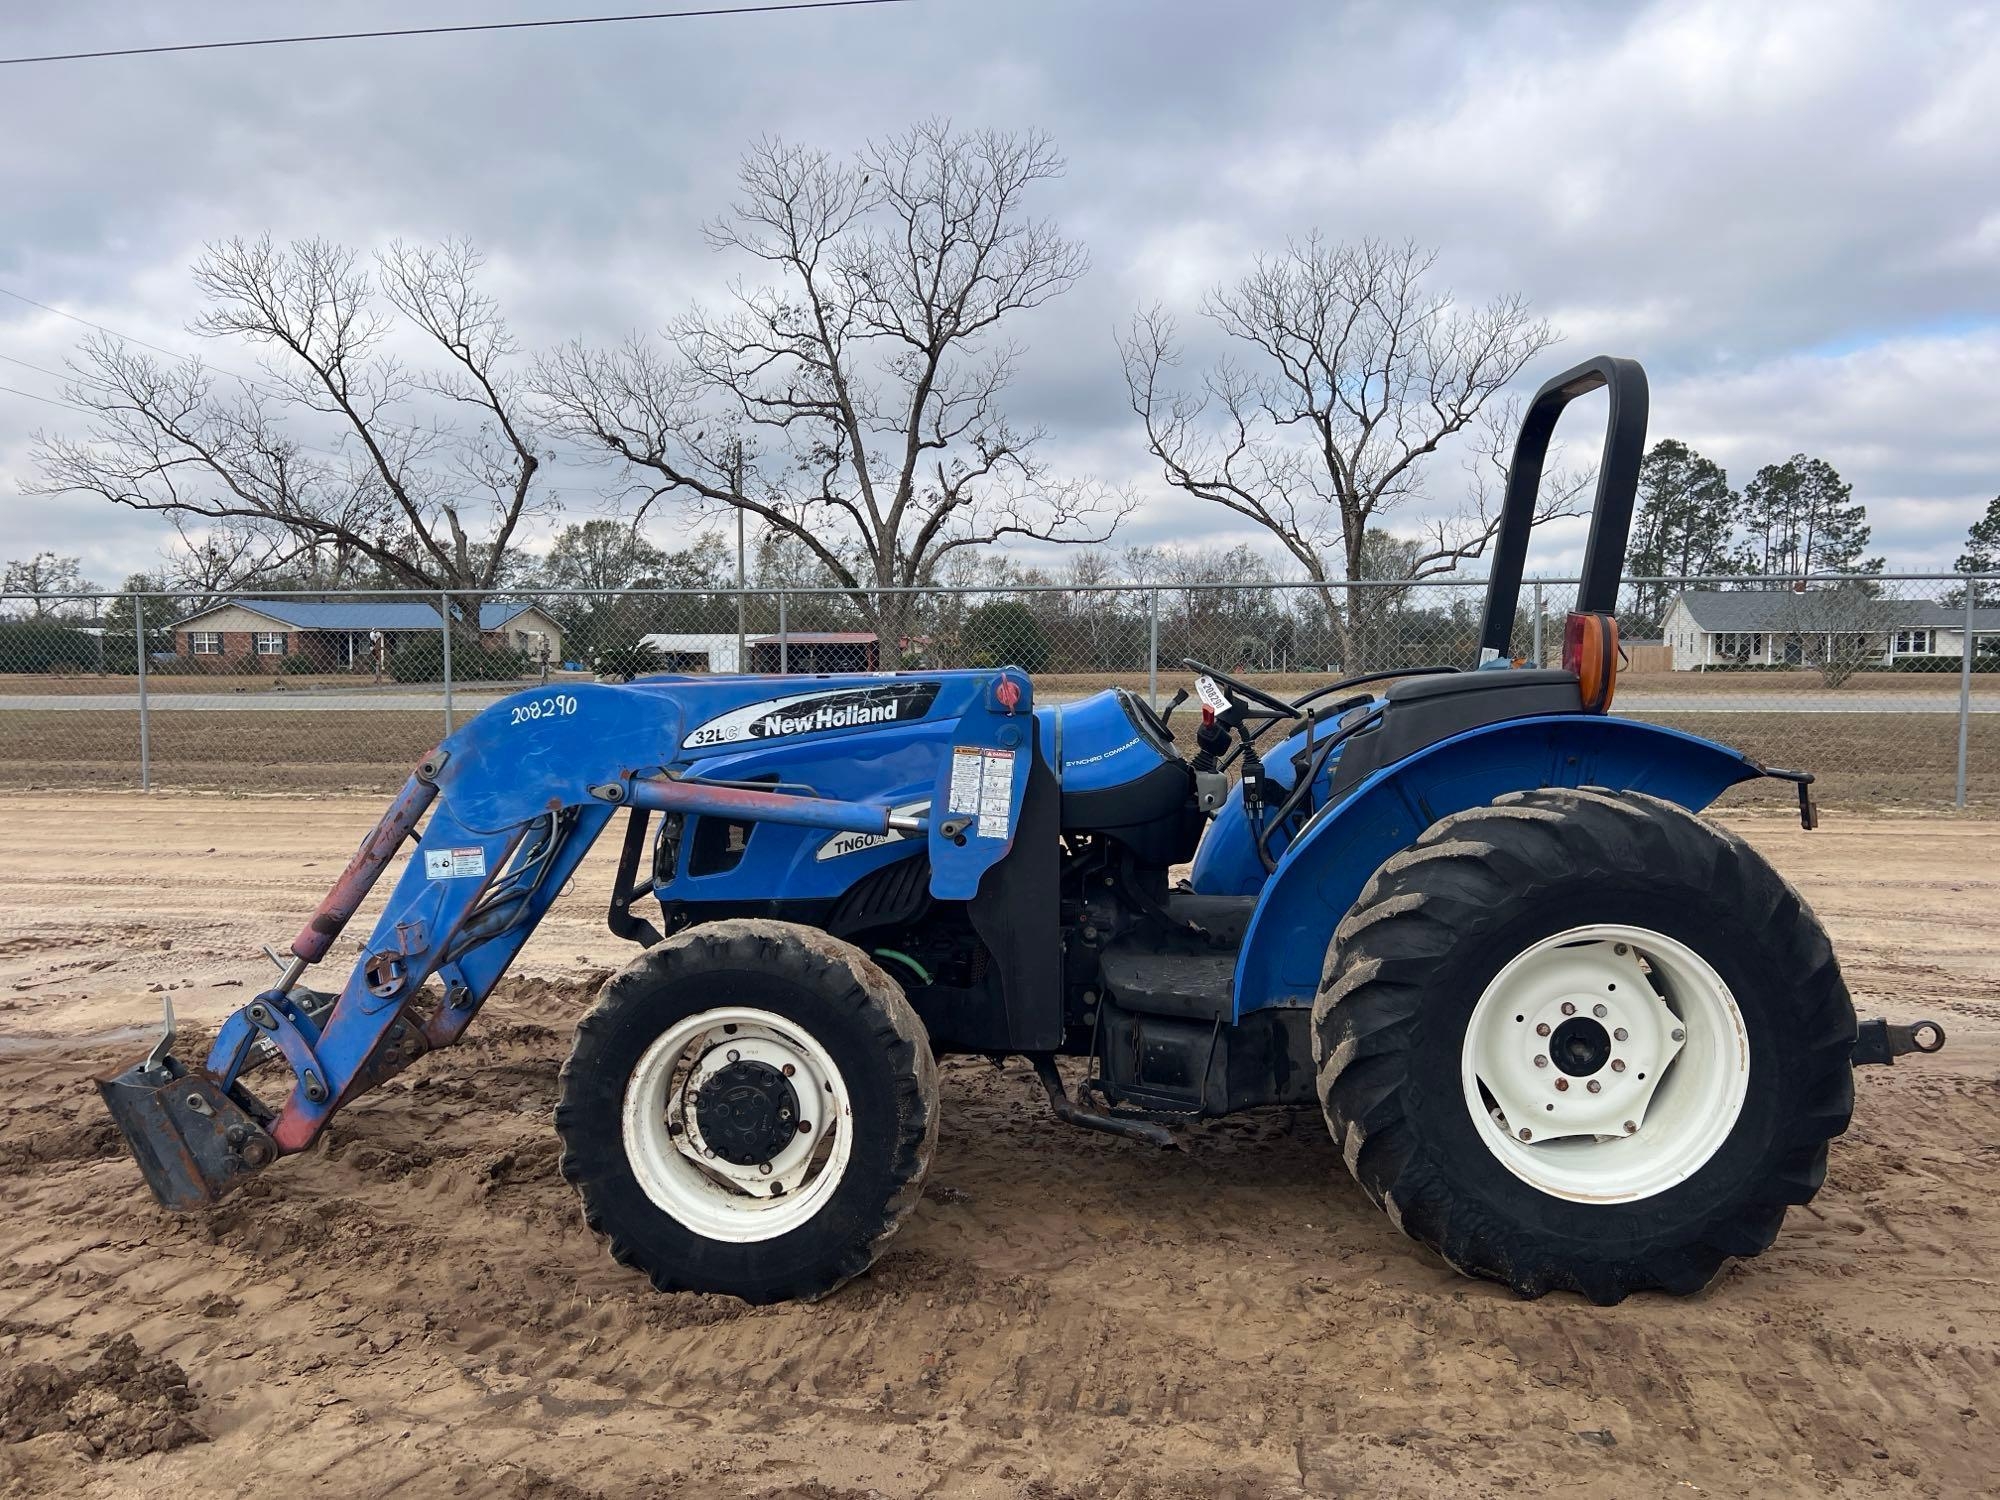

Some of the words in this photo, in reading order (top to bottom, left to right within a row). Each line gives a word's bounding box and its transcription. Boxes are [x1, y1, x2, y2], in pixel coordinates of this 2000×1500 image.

[511, 695, 577, 725] 208290
[1203, 683, 1225, 709] 208290
[765, 714, 815, 736] New
[816, 699, 898, 729] Holland
[1065, 755, 1103, 767] SYNCHRO
[1103, 737, 1140, 758] COMMAND
